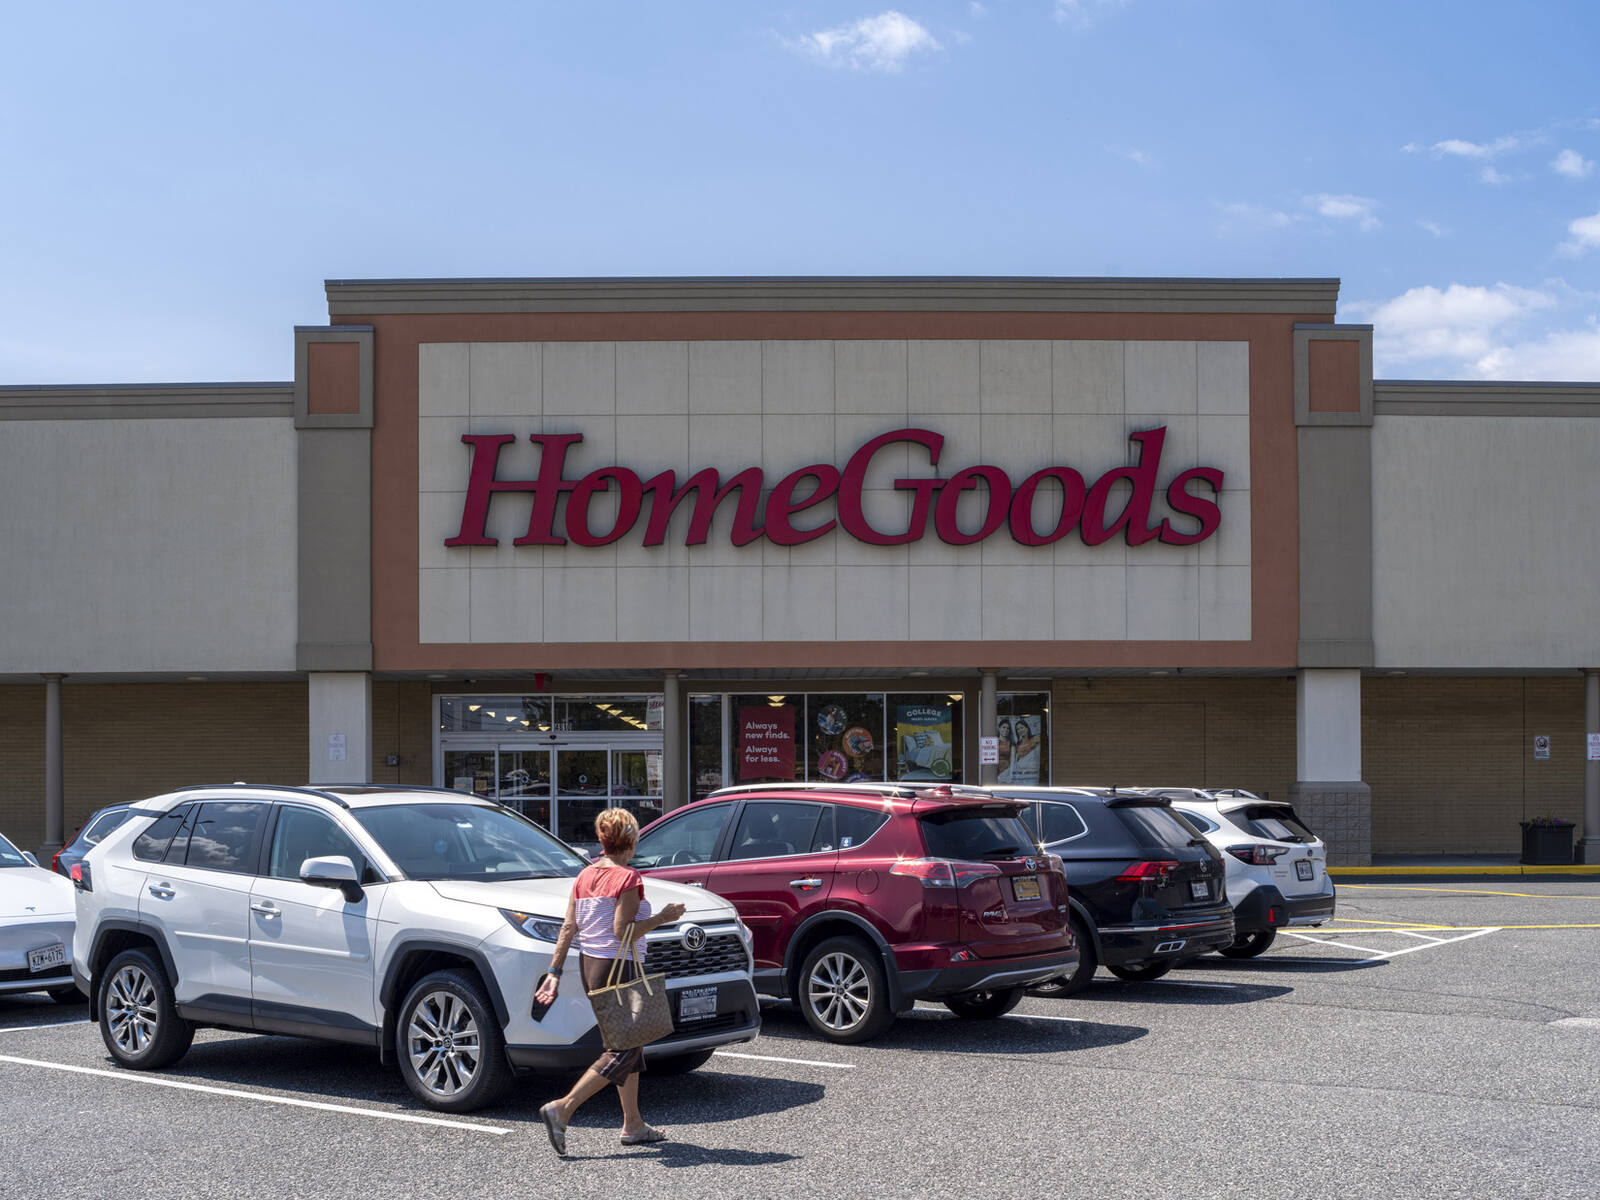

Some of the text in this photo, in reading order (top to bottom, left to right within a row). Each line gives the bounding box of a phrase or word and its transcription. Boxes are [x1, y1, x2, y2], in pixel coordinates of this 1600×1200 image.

[445, 425, 1224, 548] HomeGoods
[906, 708, 942, 717] COLLEGE
[745, 721, 778, 733] Always
[745, 731, 790, 740] new finds.
[745, 745, 778, 756] Always
[745, 754, 780, 763] for less.
